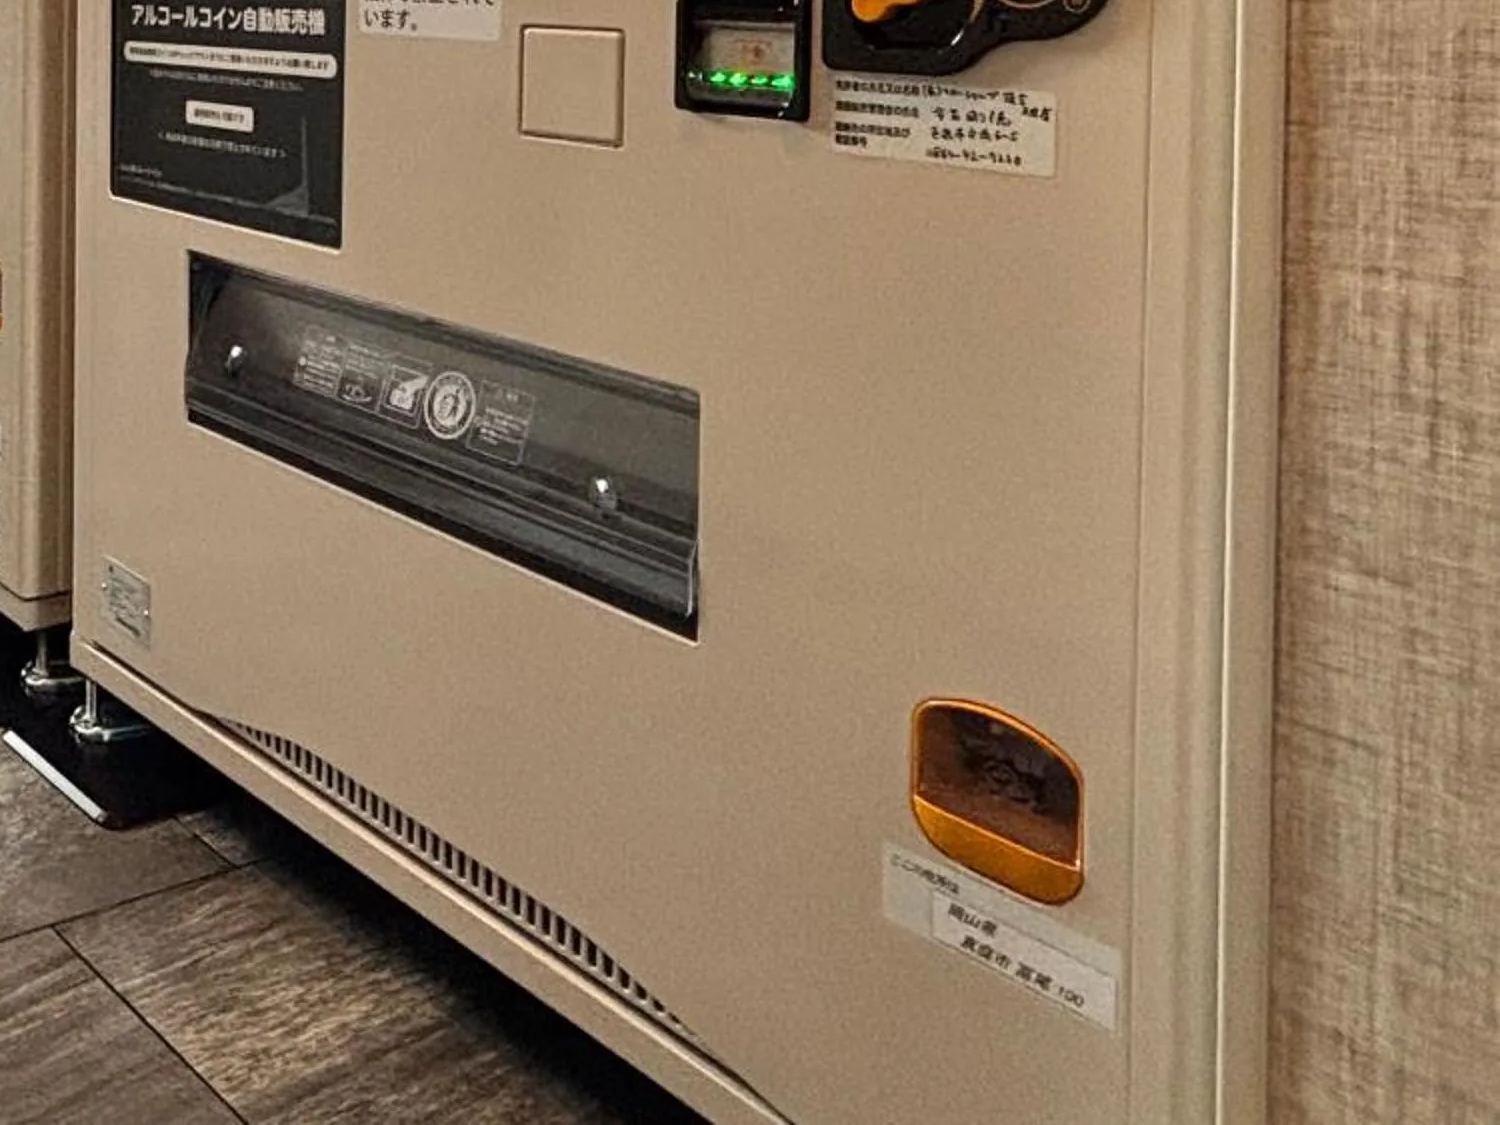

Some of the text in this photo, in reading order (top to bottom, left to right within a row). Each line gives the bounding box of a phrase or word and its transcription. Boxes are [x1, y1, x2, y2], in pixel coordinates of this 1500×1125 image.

[131, 4, 326, 36] アルコールコイン自動販売機
[364, 8, 418, 31] います。
